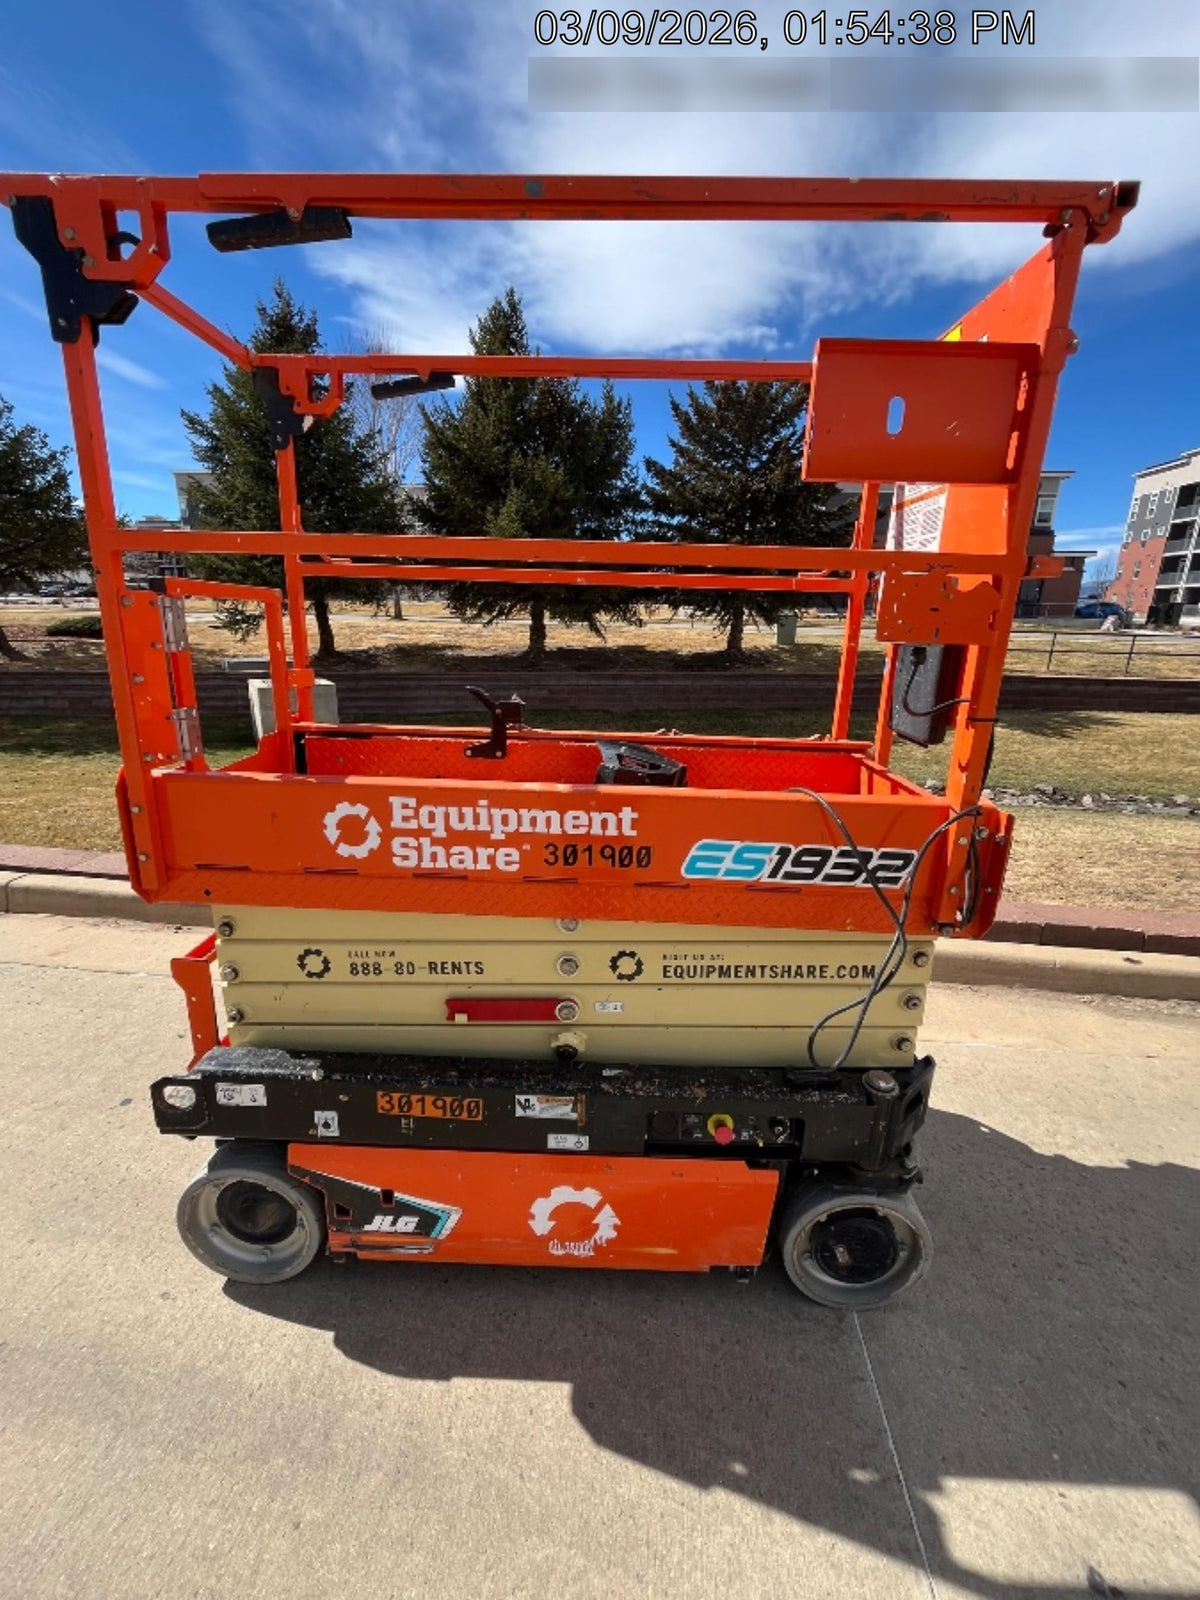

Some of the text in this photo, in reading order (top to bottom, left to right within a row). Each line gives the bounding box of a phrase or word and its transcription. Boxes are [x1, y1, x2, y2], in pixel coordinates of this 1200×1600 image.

[389, 796, 639, 840] Equipment
[391, 836, 521, 872] Share
[543, 843, 653, 869] 301900
[682, 840, 917, 888] ES1932
[349, 961, 484, 976] 888-80-RENTS
[662, 964, 876, 980] EQUIPMENTSHARE.COM
[379, 1092, 483, 1119] 301900
[364, 1215, 420, 1232] JLG
